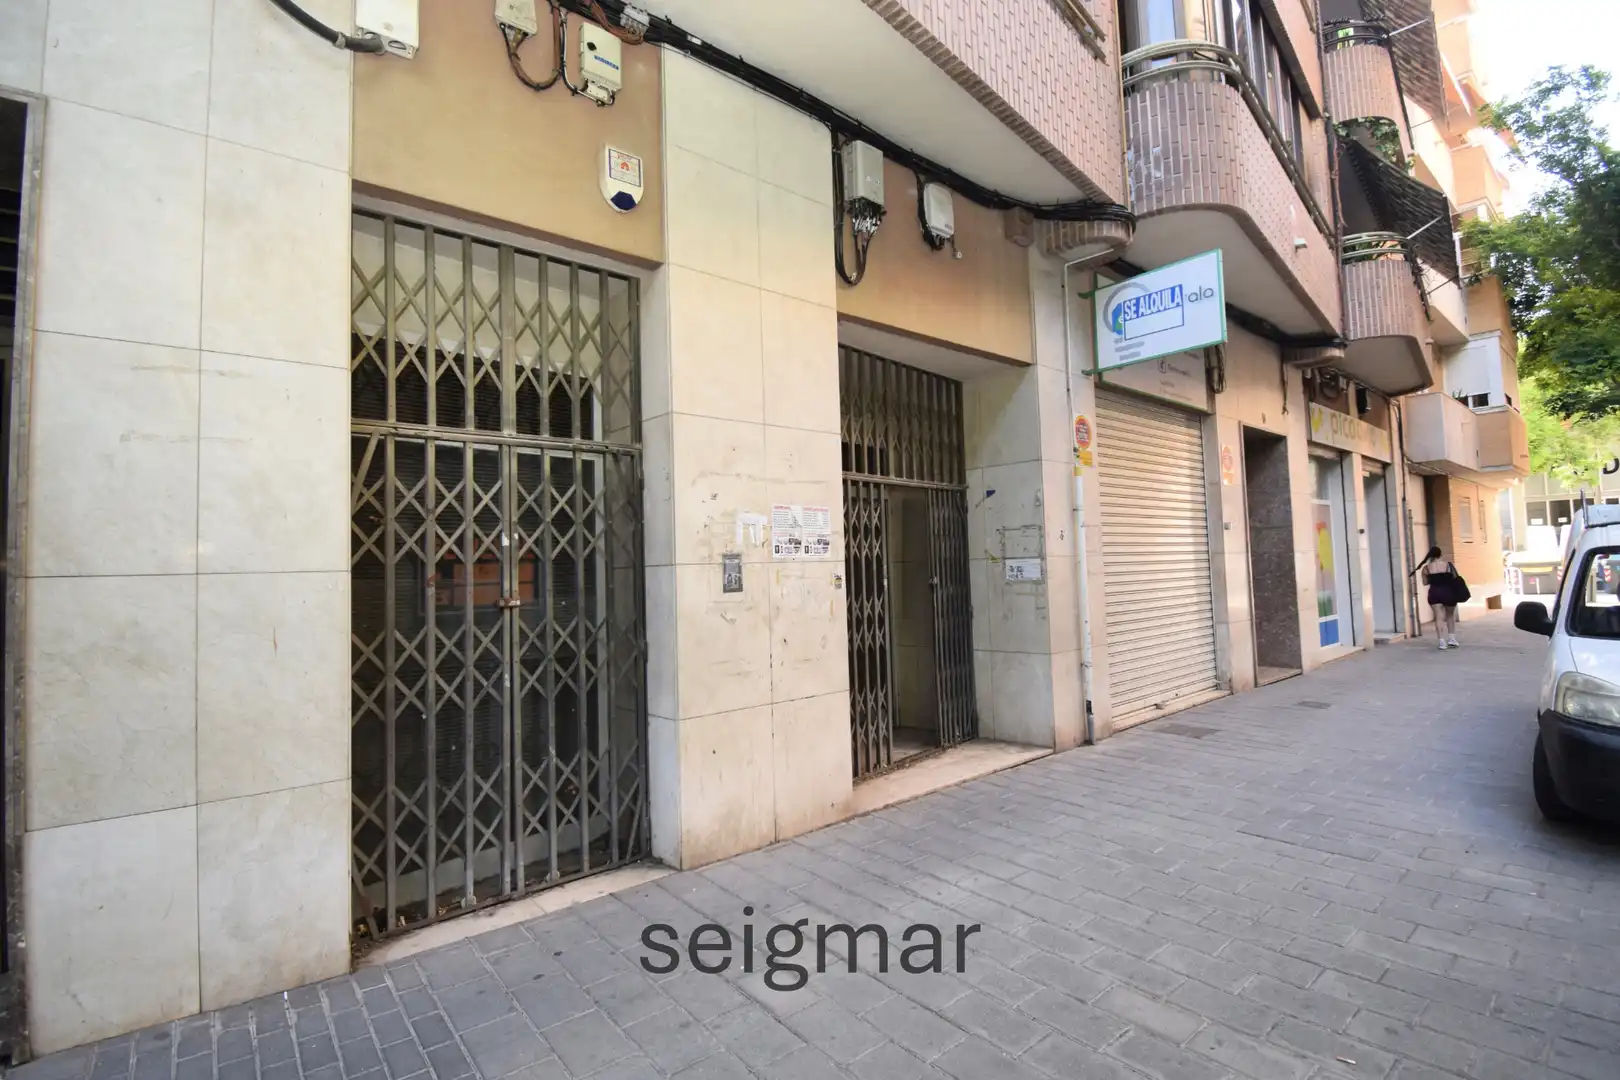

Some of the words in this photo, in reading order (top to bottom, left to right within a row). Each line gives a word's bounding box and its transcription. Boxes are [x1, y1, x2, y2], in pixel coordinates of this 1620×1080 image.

[1124, 299, 1137, 320] SE
[1138, 286, 1182, 317] ALQUILA
[1185, 285, 1214, 303] ala
